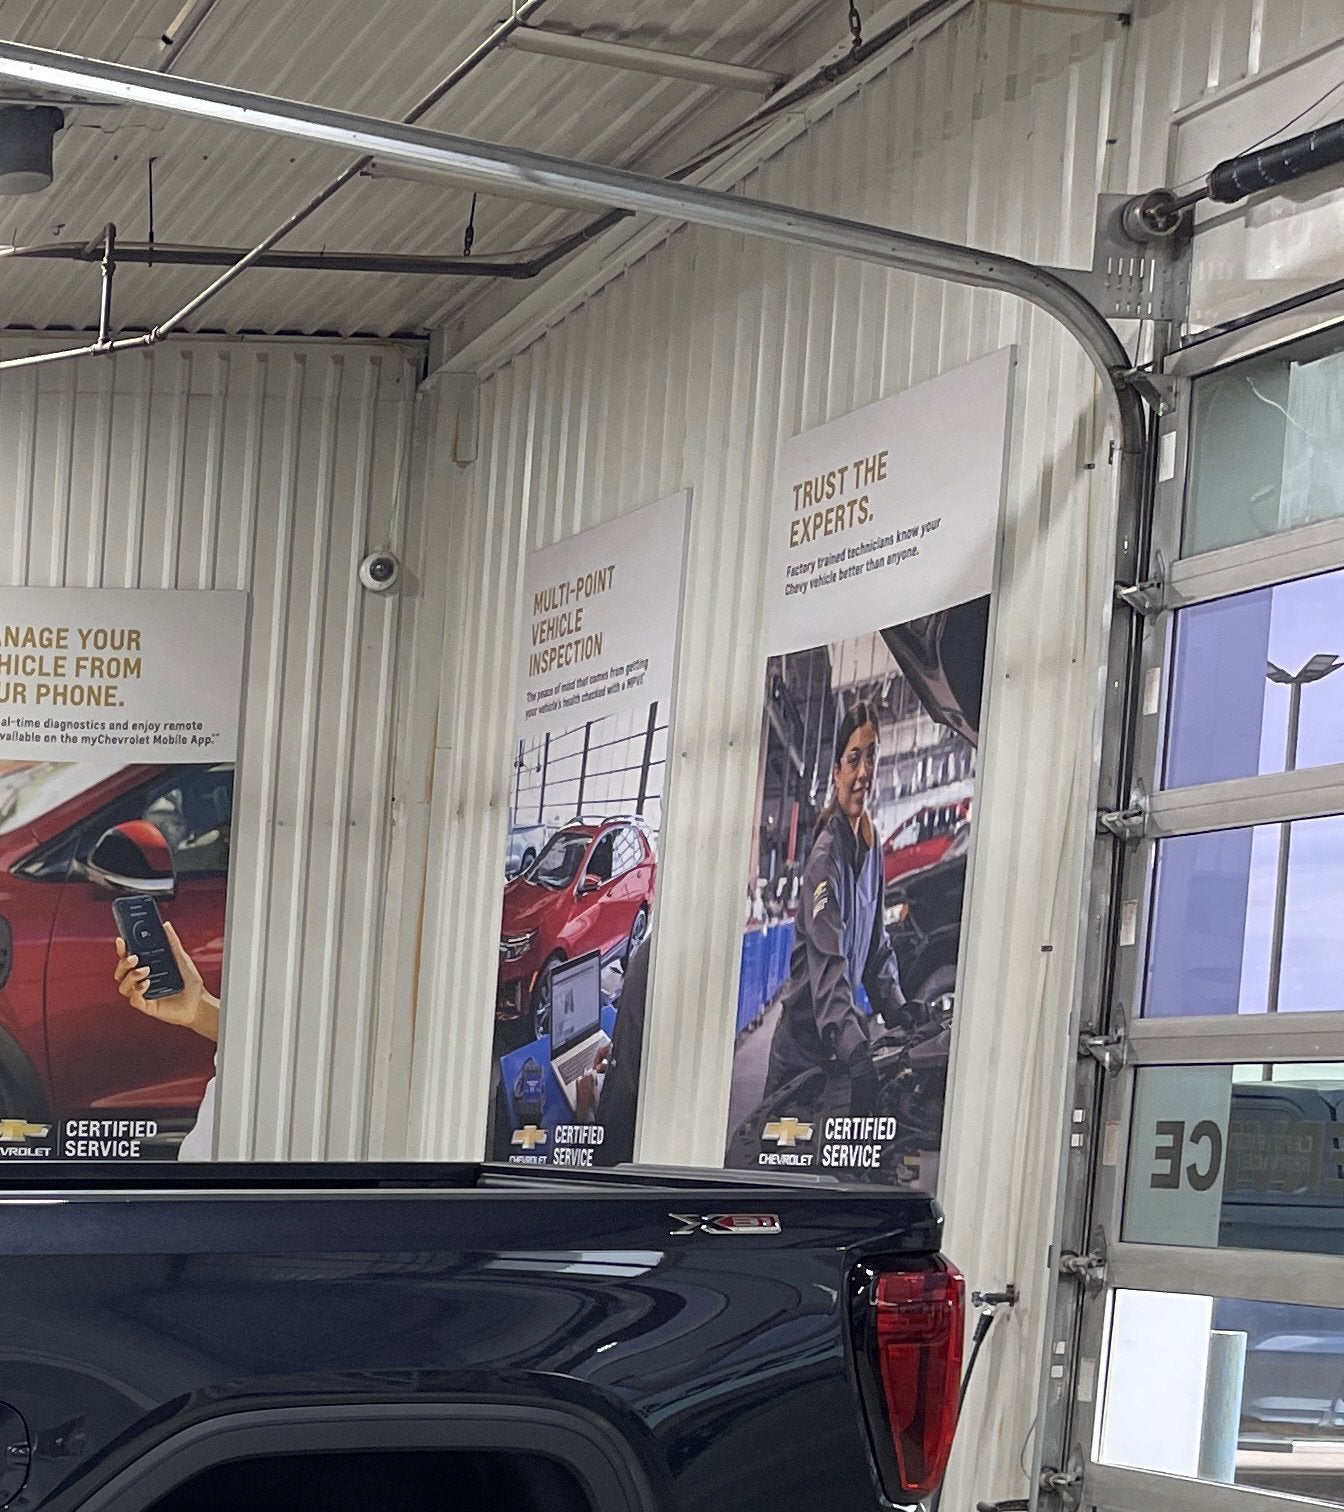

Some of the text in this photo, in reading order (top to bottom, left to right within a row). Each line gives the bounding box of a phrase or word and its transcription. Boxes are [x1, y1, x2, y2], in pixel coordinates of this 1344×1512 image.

[793, 450, 888, 512] TRUST THE
[790, 496, 873, 548] EXPERTS.
[533, 565, 615, 616] MULTI-POINT
[532, 608, 583, 646] VEHICLE
[78, 628, 142, 651] YOUR
[528, 632, 603, 678] INSPECTION
[76, 657, 142, 679] FROM
[36, 684, 124, 707] PHONE.
[44, 718, 106, 732] diagnostics
[109, 719, 128, 731] and
[131, 720, 160, 733] enjoy
[164, 721, 203, 731] remote
[44, 734, 56, 743] on
[60, 733, 77, 744] the
[81, 734, 150, 746] myChevrolet
[154, 734, 187, 745] Mobile
[66, 1120, 158, 1138] CERTIFIED
[555, 1125, 604, 1145] CERTIFIED
[825, 1118, 897, 1140] CERTIFIED
[64, 1140, 140, 1157] SERVICE
[553, 1148, 594, 1167] SERVICE
[822, 1144, 882, 1168] SERVICE
[758, 1154, 813, 1166] CHEVROLET
